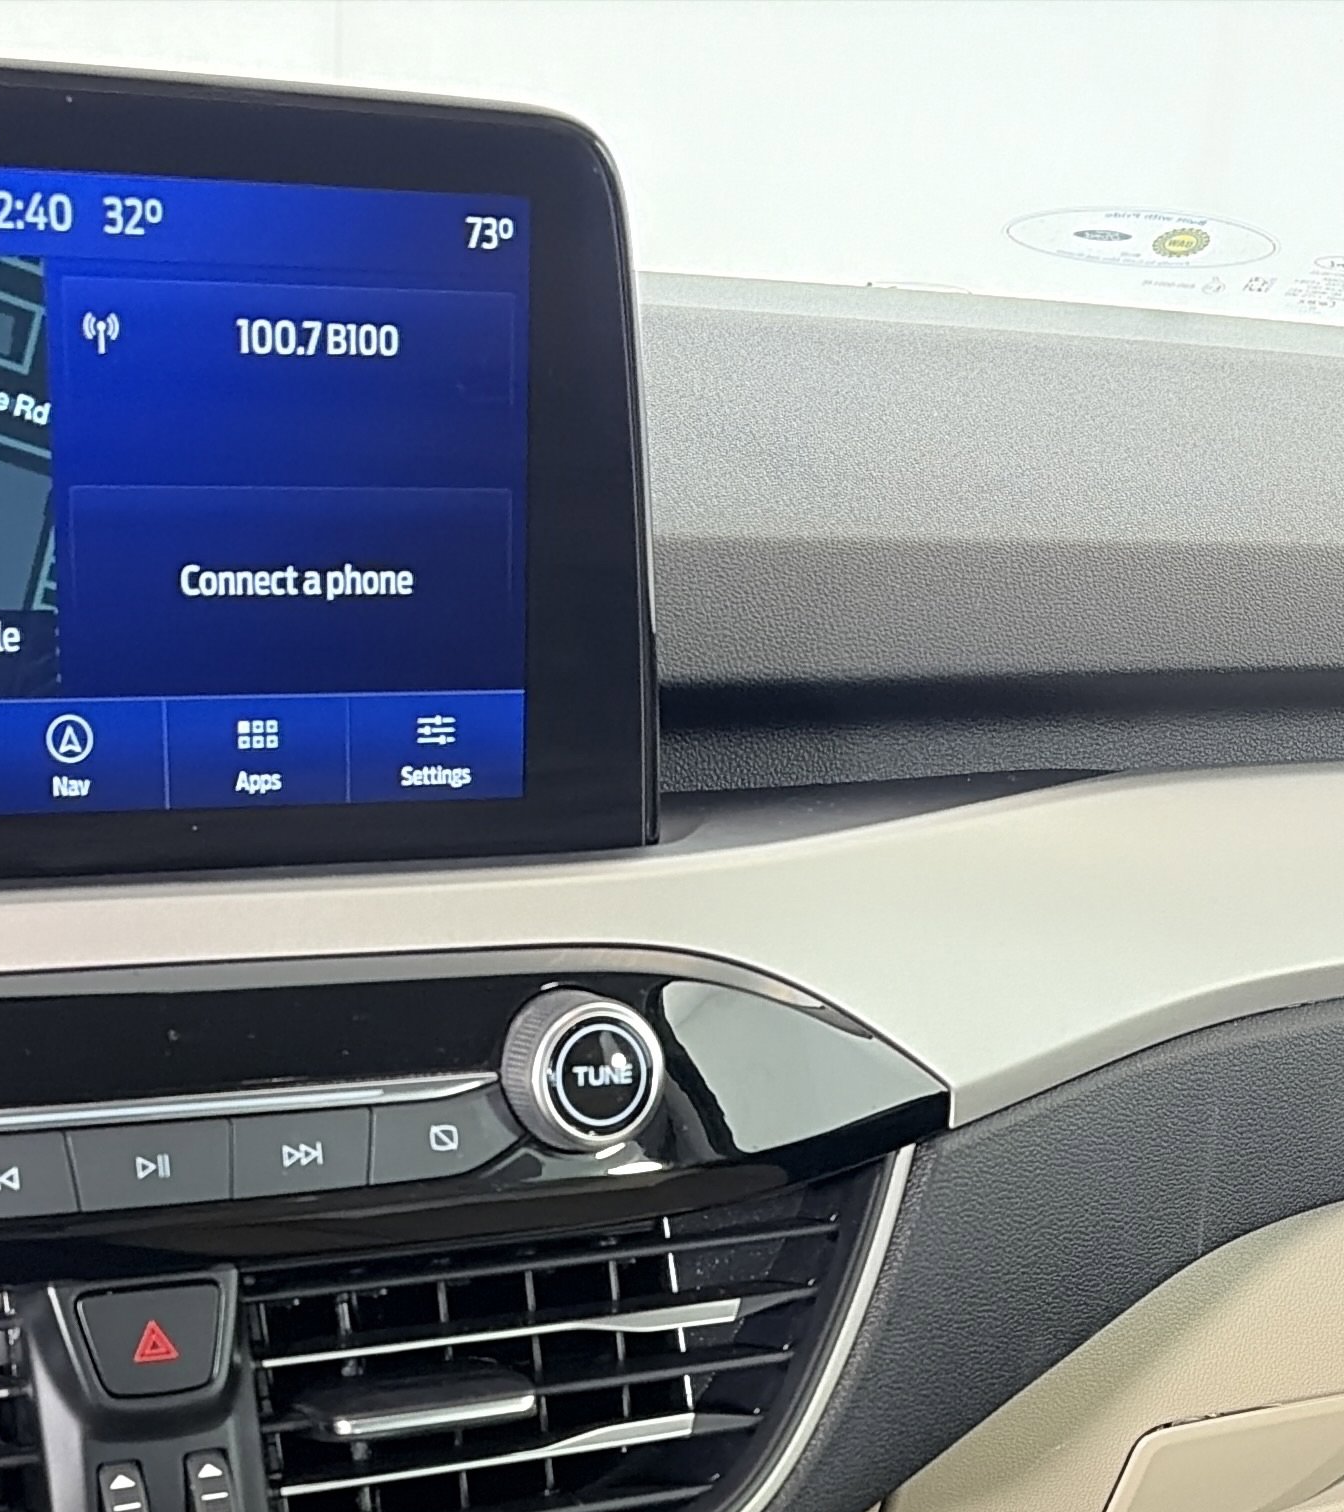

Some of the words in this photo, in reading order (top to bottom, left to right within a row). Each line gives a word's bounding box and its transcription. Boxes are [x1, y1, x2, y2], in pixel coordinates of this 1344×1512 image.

[236, 319, 320, 355] 100.7
[327, 323, 398, 356] B100
[13, 393, 50, 425] Rd
[180, 564, 298, 597] Connect
[304, 570, 323, 596] a
[327, 564, 413, 601] phone
[52, 775, 90, 798] Nav
[235, 770, 282, 793] Apps
[400, 765, 471, 789] Settings
[571, 1063, 633, 1087] TUNE
